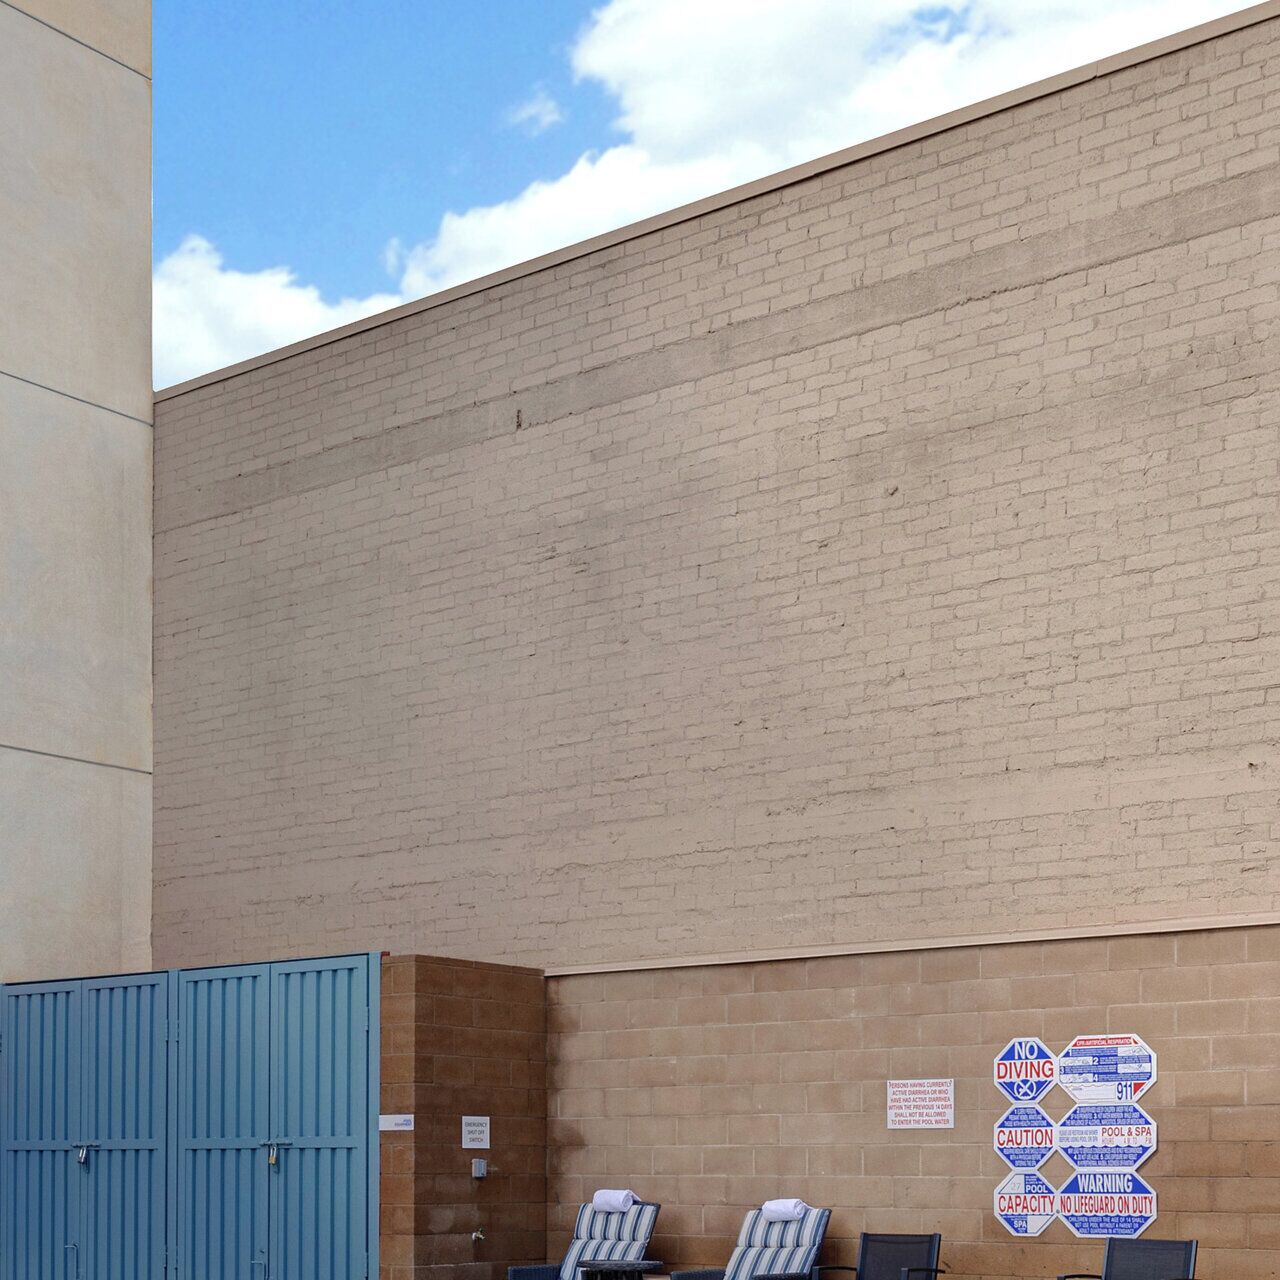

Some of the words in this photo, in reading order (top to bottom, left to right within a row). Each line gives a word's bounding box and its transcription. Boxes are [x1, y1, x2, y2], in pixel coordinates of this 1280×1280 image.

[1014, 1041, 1038, 1060] NO
[997, 1060, 1054, 1079] DIVING
[1117, 1082, 1132, 1100] 911
[997, 1129, 1053, 1146] CAUTION
[1102, 1127, 1125, 1136] POOL
[1127, 1127, 1133, 1136] &
[1135, 1127, 1151, 1136] SPA
[1078, 1174, 1132, 1192] WARNING
[998, 1195, 1055, 1213] CAPACITY
[1060, 1196, 1071, 1213] NO
[1074, 1196, 1115, 1213] LIFEGUARD
[1118, 1196, 1129, 1213] ON
[1132, 1196, 1152, 1213] DUTY
[1014, 1220, 1027, 1228] SPA
